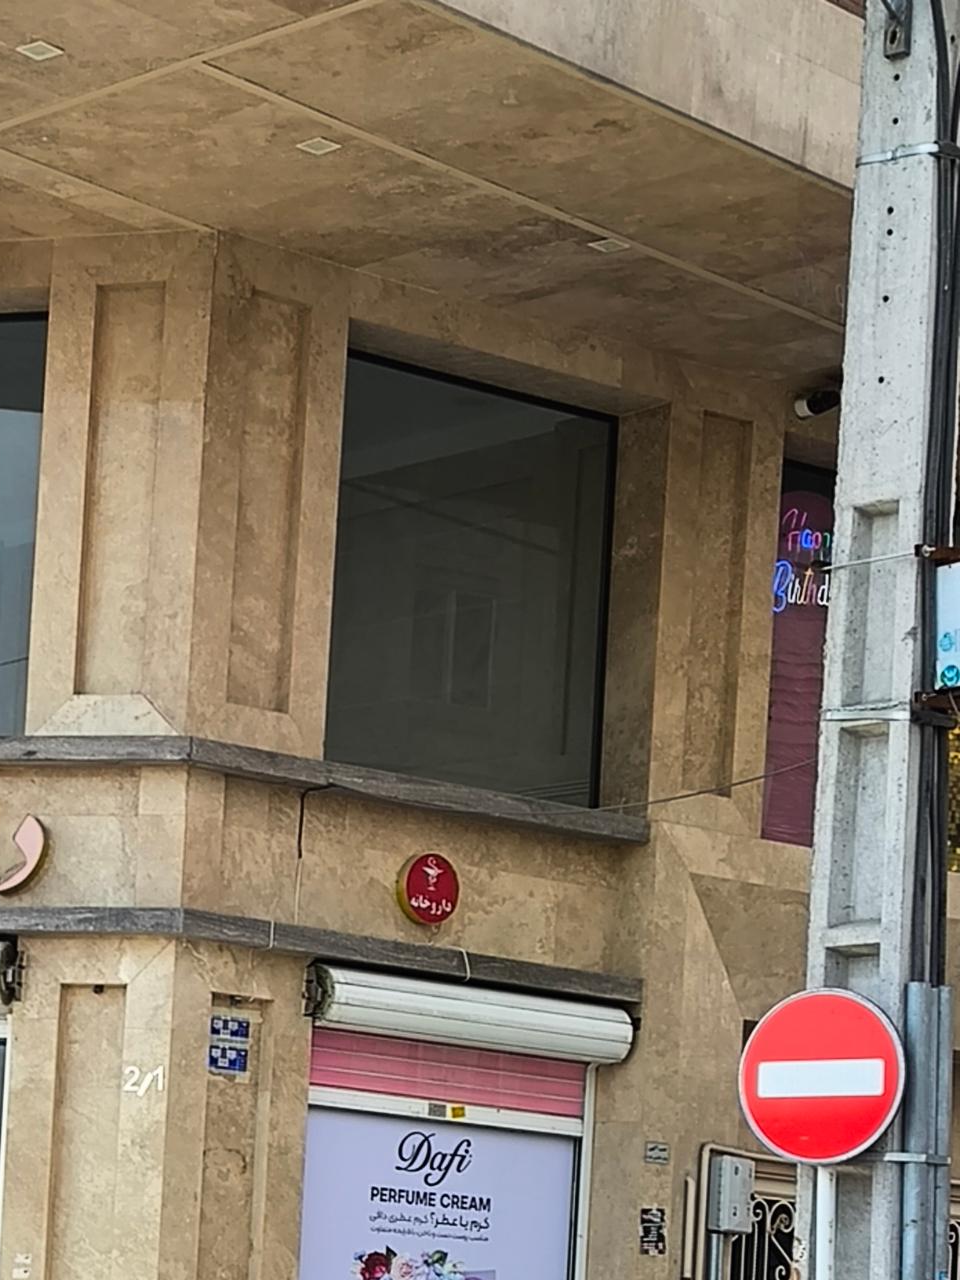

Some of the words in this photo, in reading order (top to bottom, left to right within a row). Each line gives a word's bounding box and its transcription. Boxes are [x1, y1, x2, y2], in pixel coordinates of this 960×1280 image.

[772, 560, 830, 612] Birthd
[123, 1065, 165, 1097] 2/1
[394, 1131, 472, 1186] Dafi
[370, 1186, 436, 1207] PERFUME
[440, 1193, 491, 1212] CREAM
[459, 1215, 469, 1231] با
[470, 1217, 490, 1232] کرم
